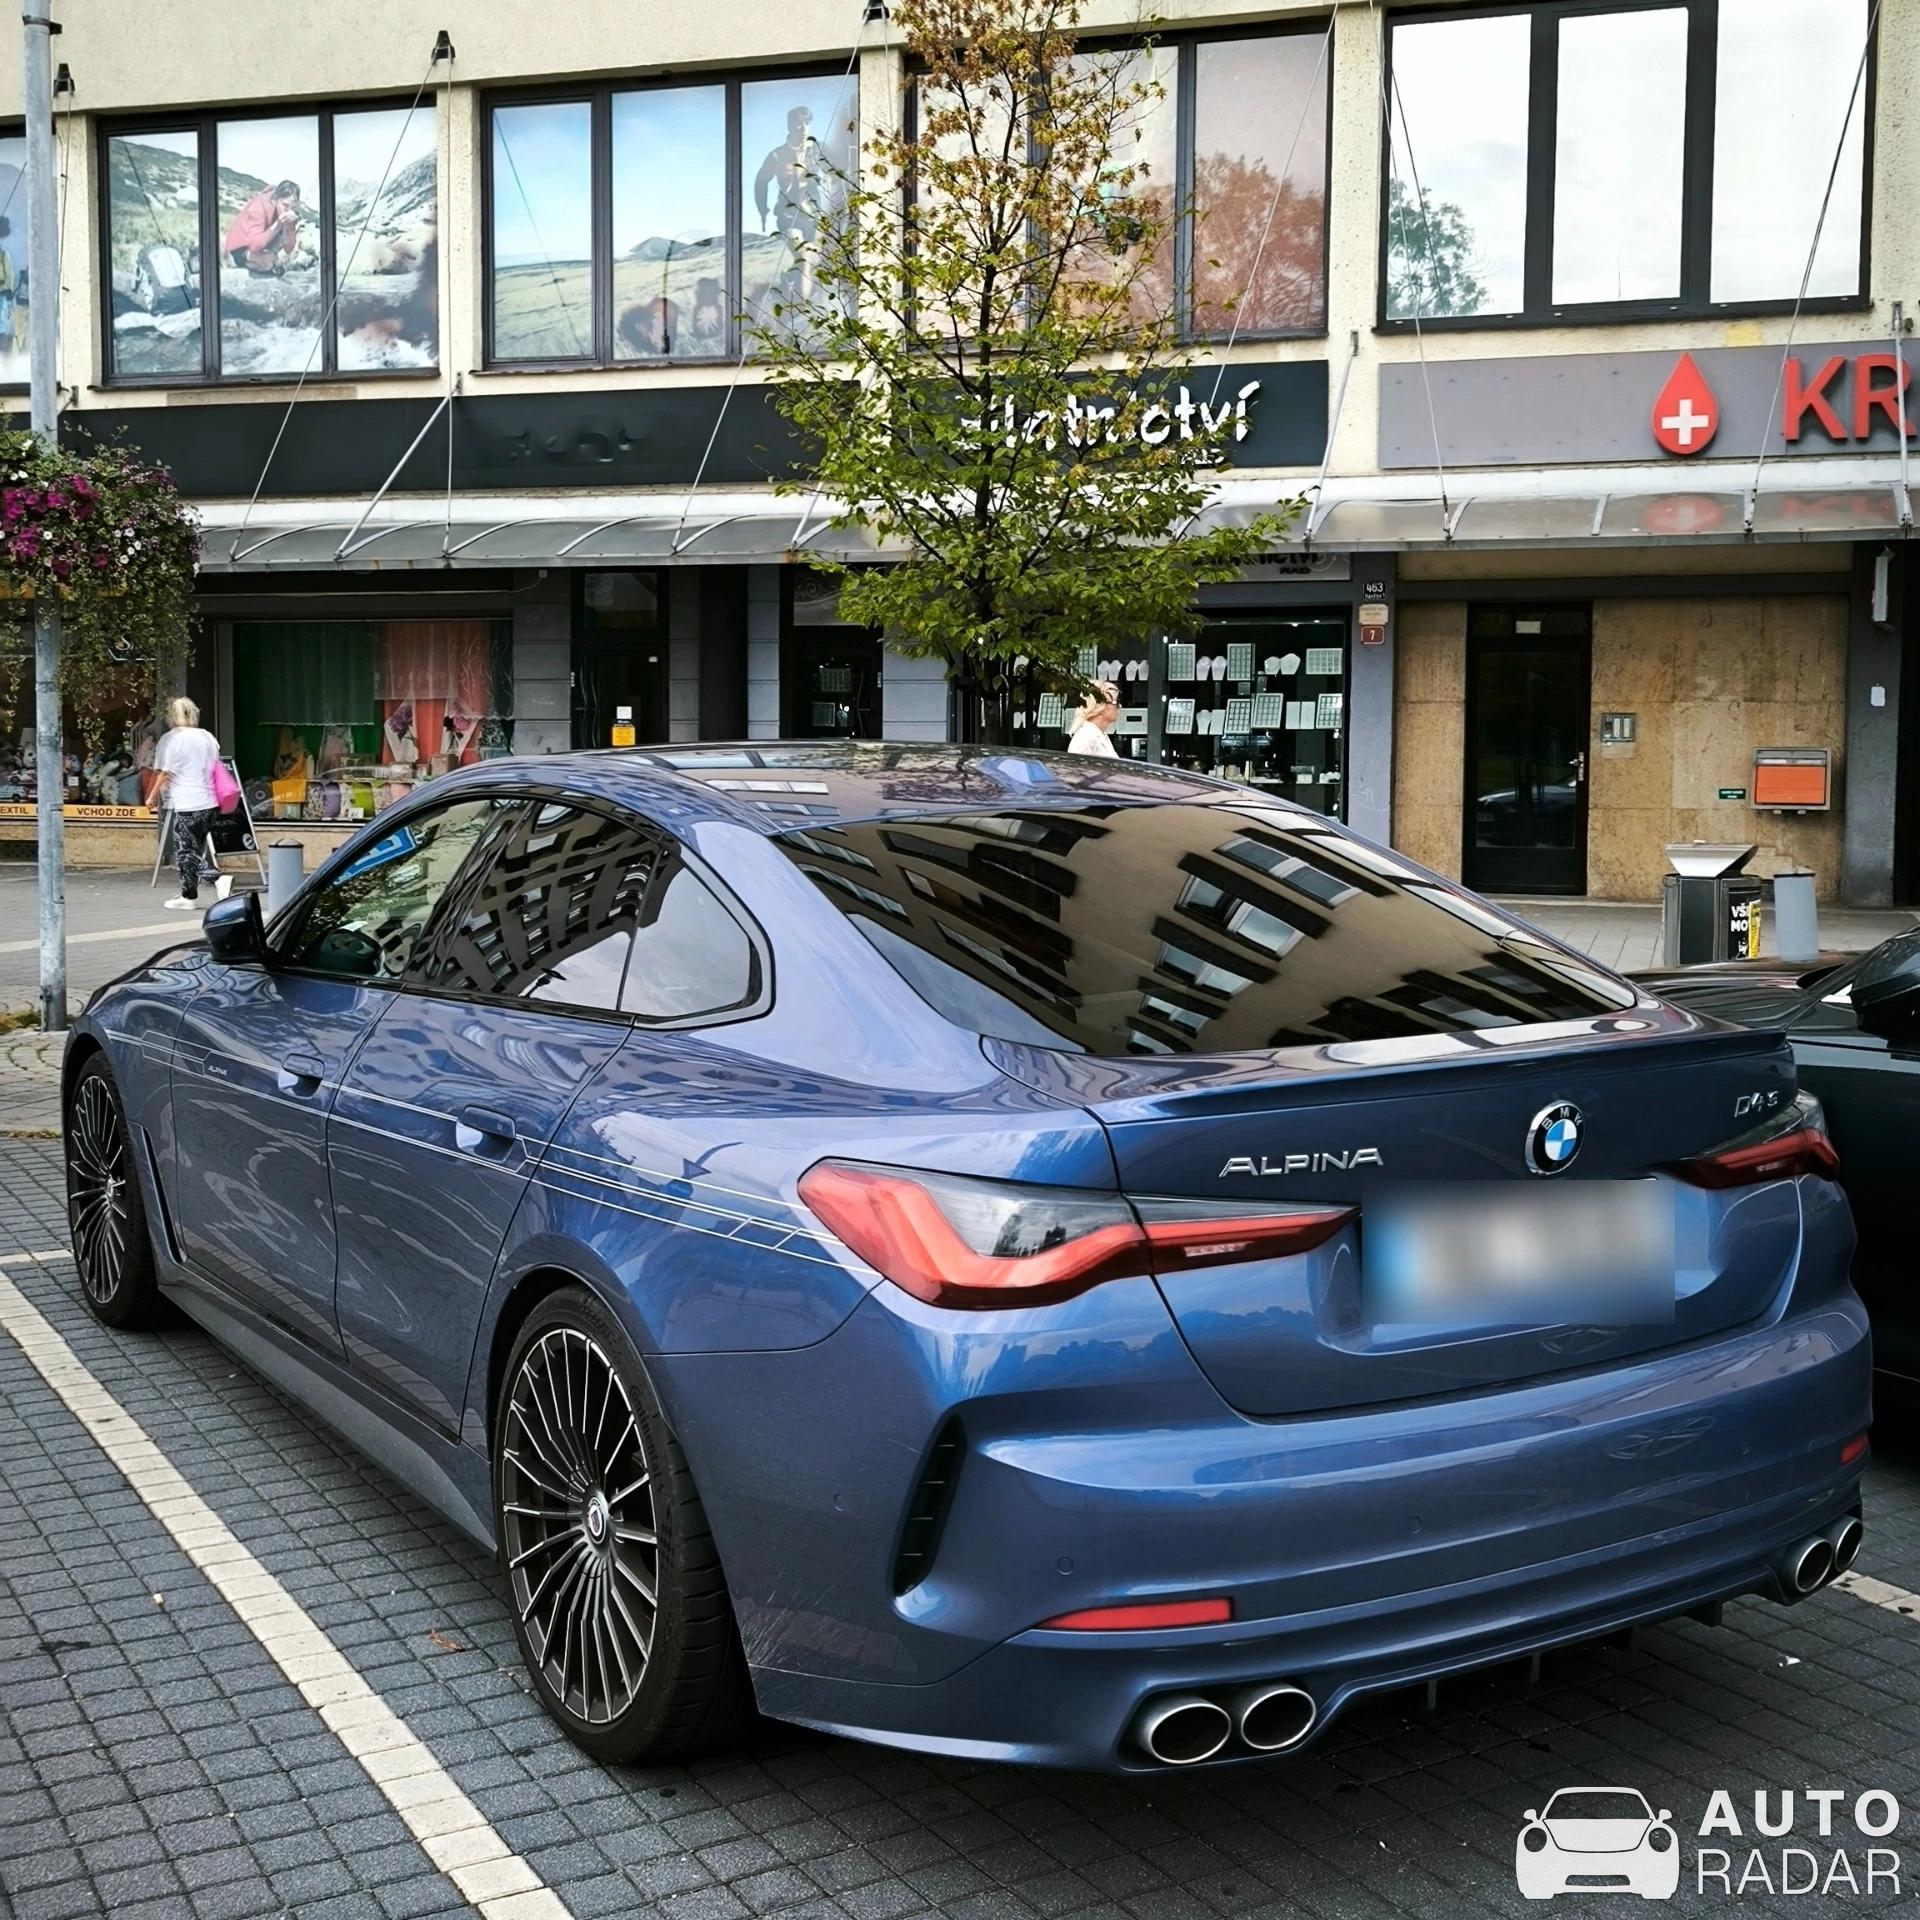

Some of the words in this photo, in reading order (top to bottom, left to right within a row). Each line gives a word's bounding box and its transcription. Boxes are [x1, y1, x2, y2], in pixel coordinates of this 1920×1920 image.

[1784, 353, 1917, 441] KR
[1370, 629, 1376, 641] 7
[0, 806, 29, 815] EXTIL
[77, 807, 113, 817] VCHOD
[1731, 902, 1750, 918] VŠ
[1541, 1106, 1583, 1130] BMW
[1218, 1148, 1385, 1178] ALPINA
